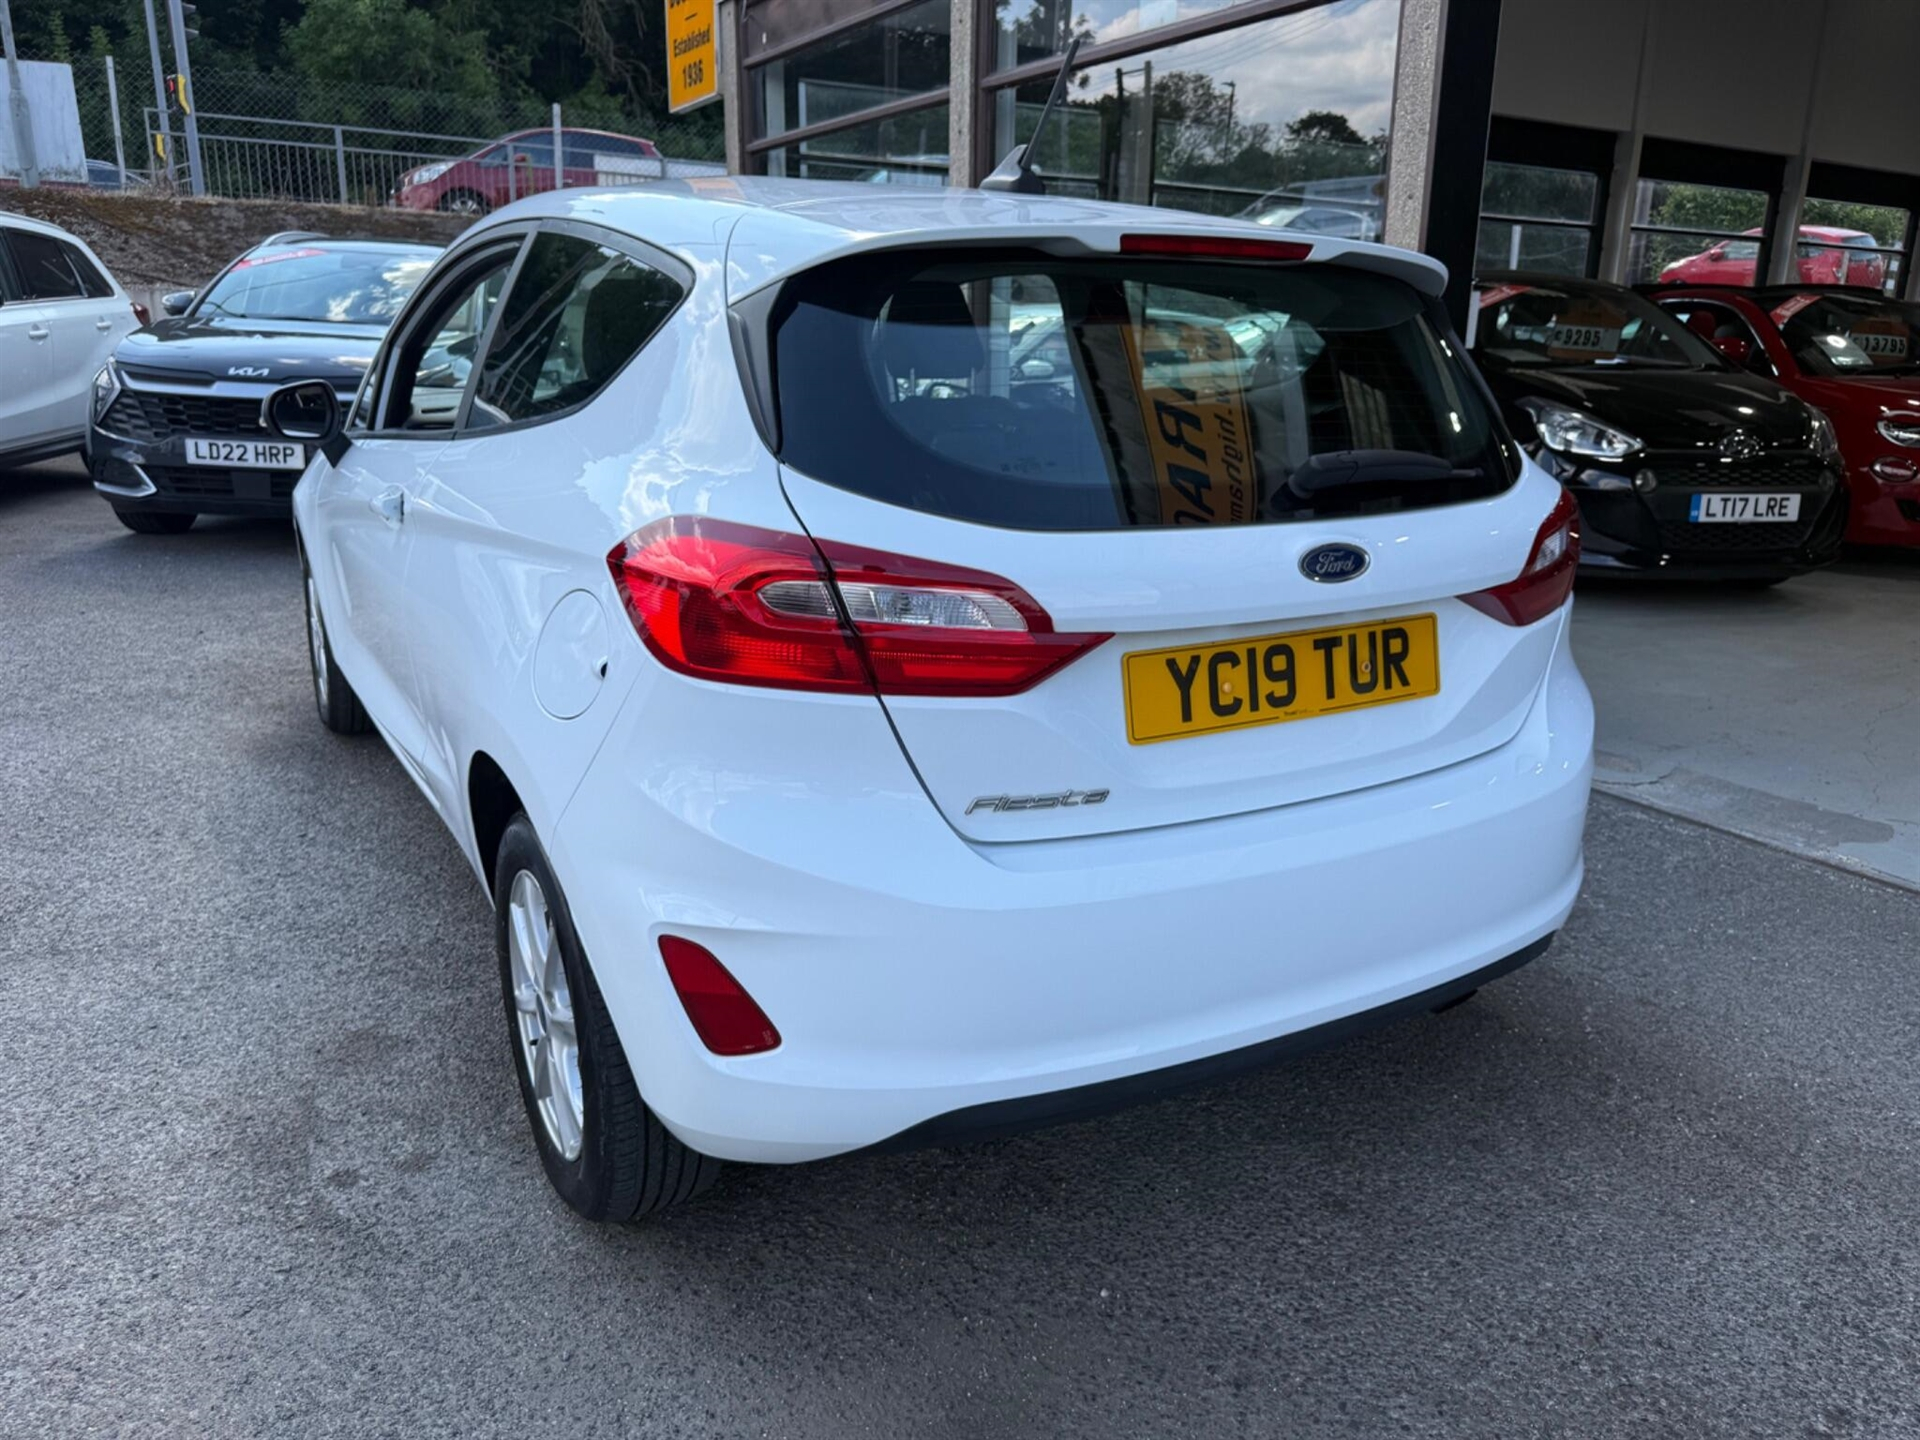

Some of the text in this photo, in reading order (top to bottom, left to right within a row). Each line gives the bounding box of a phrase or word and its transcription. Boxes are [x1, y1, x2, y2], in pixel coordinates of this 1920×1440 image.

[673, 23, 711, 58] Established
[682, 58, 703, 89] 1936
[194, 441, 296, 464] LD22 HRP
[1704, 496, 1791, 518] LT17 LRE
[1315, 551, 1356, 574] Ford
[1165, 626, 1411, 724] YC19 TUR
[964, 787, 1110, 816] Fiesta
